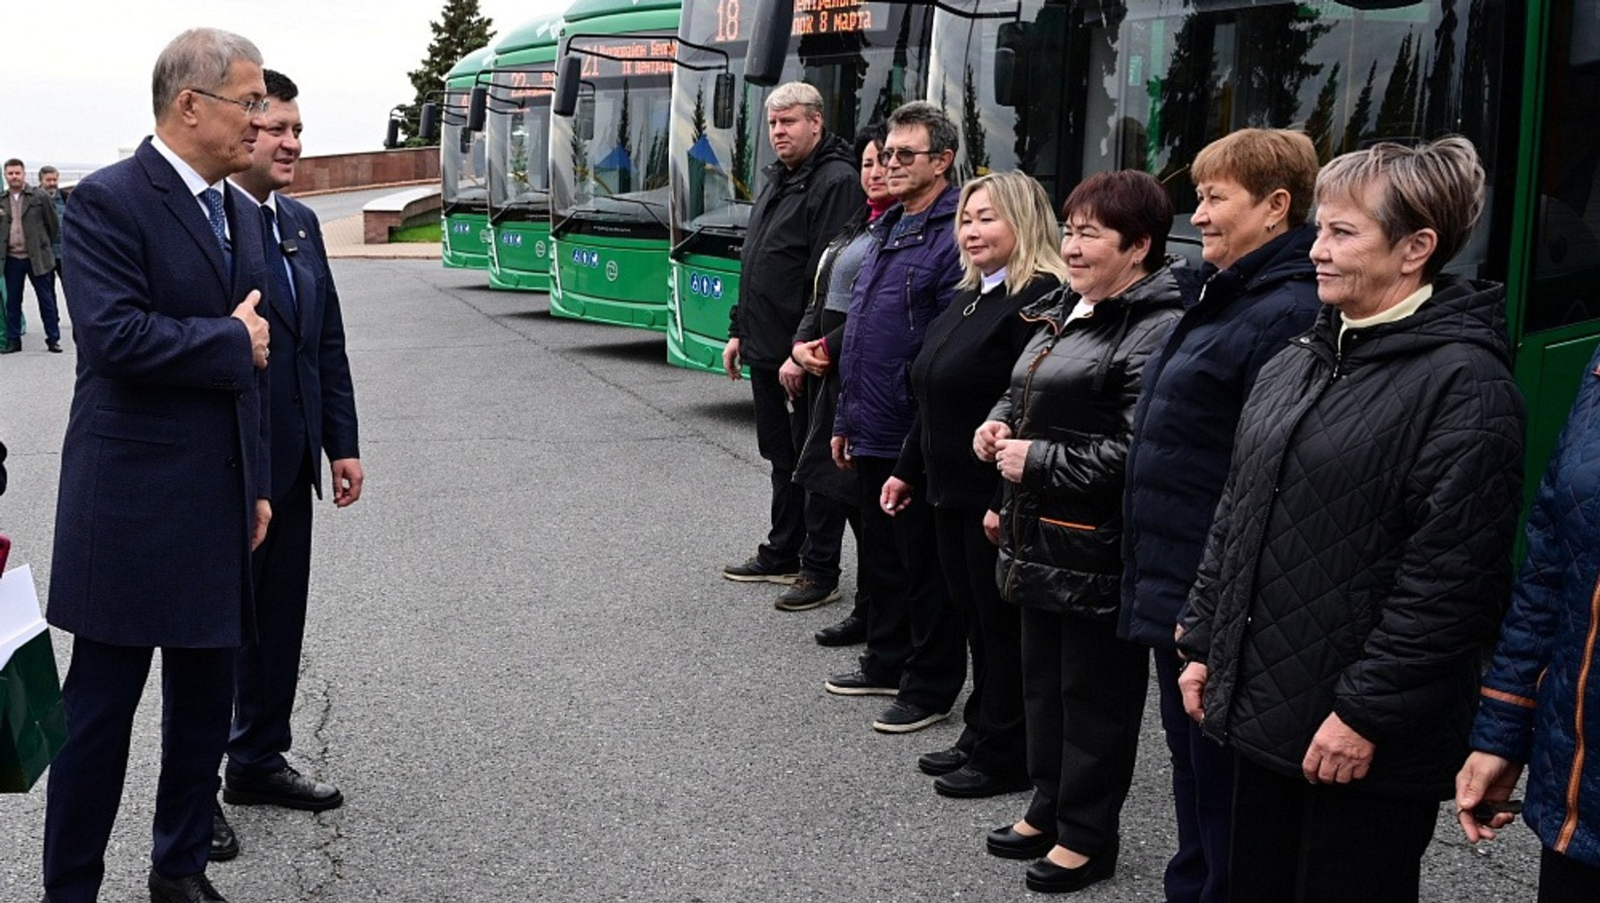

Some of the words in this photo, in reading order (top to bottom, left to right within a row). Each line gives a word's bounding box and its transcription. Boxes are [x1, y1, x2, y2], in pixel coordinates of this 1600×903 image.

[715, 0, 739, 42] 18
[818, 11, 829, 33] 8
[833, 10, 872, 32] марта
[581, 44, 599, 77] 21
[511, 72, 526, 98] 22
